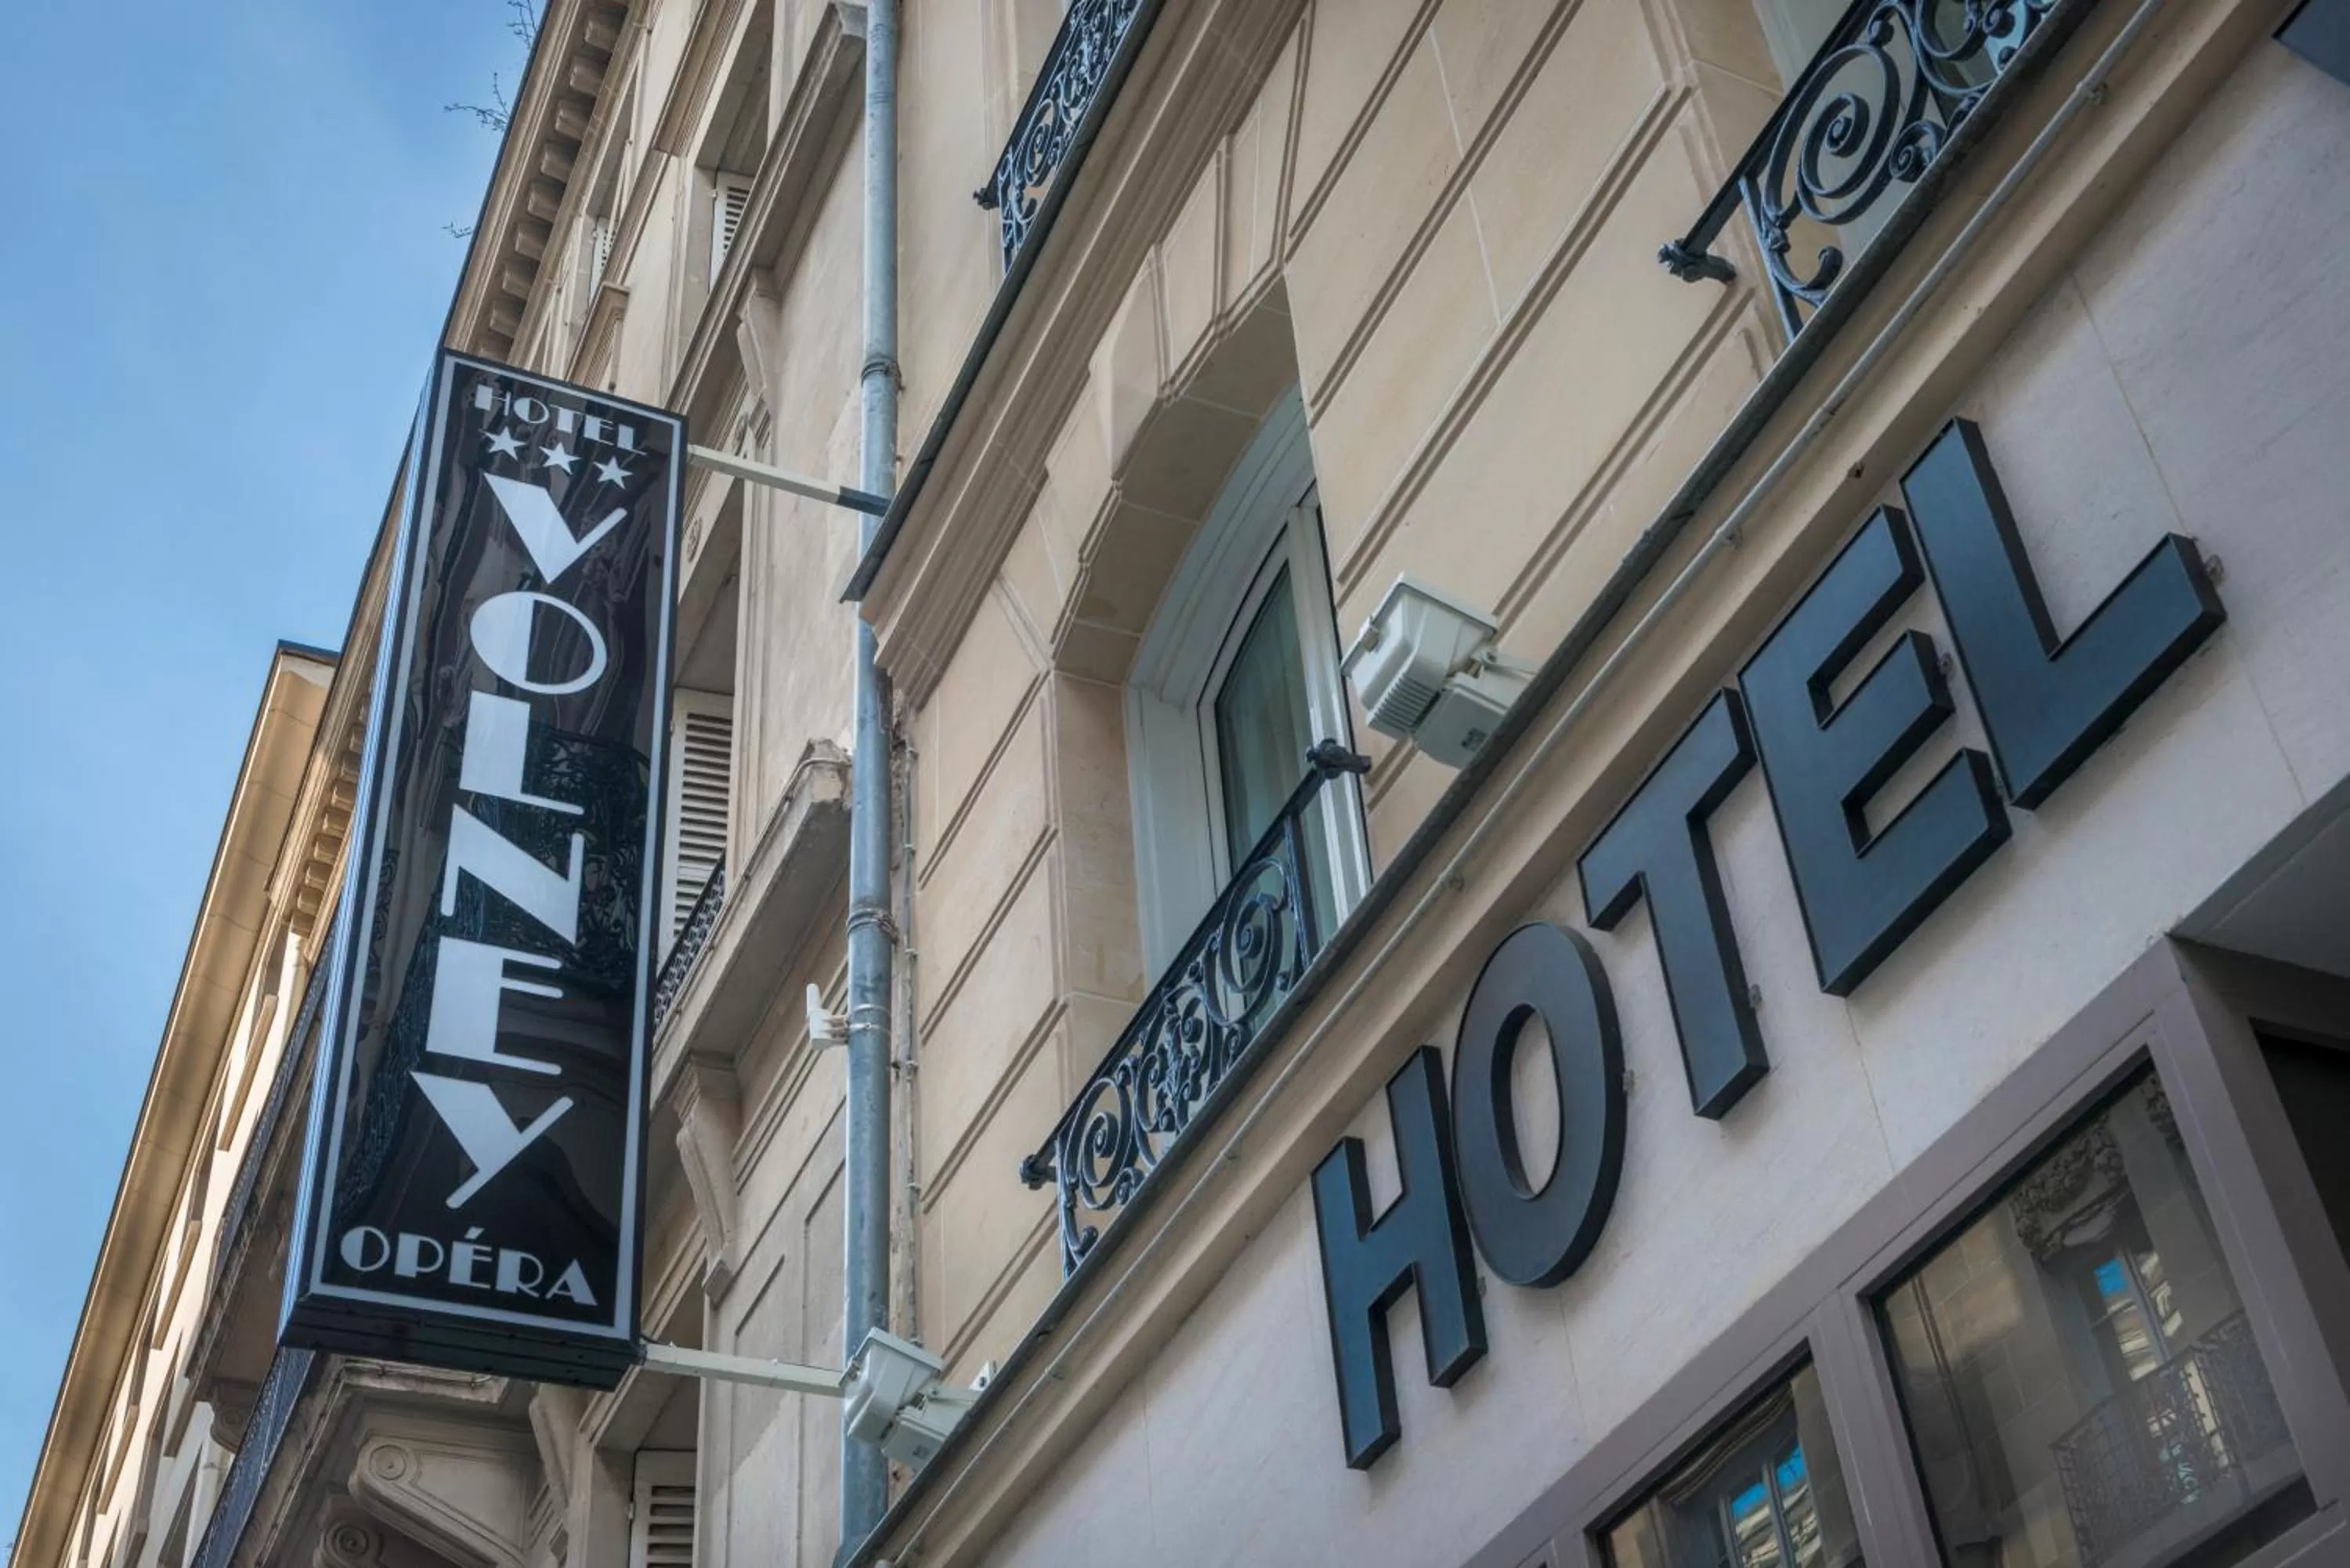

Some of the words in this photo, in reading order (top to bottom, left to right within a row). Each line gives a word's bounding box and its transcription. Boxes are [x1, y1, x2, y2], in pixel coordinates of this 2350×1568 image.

[474, 384, 648, 455] HOTEL
[409, 472, 627, 1209] VOLNEY
[1311, 417, 2227, 1471] HOTEL
[340, 1226, 598, 1306] OPÉRA
